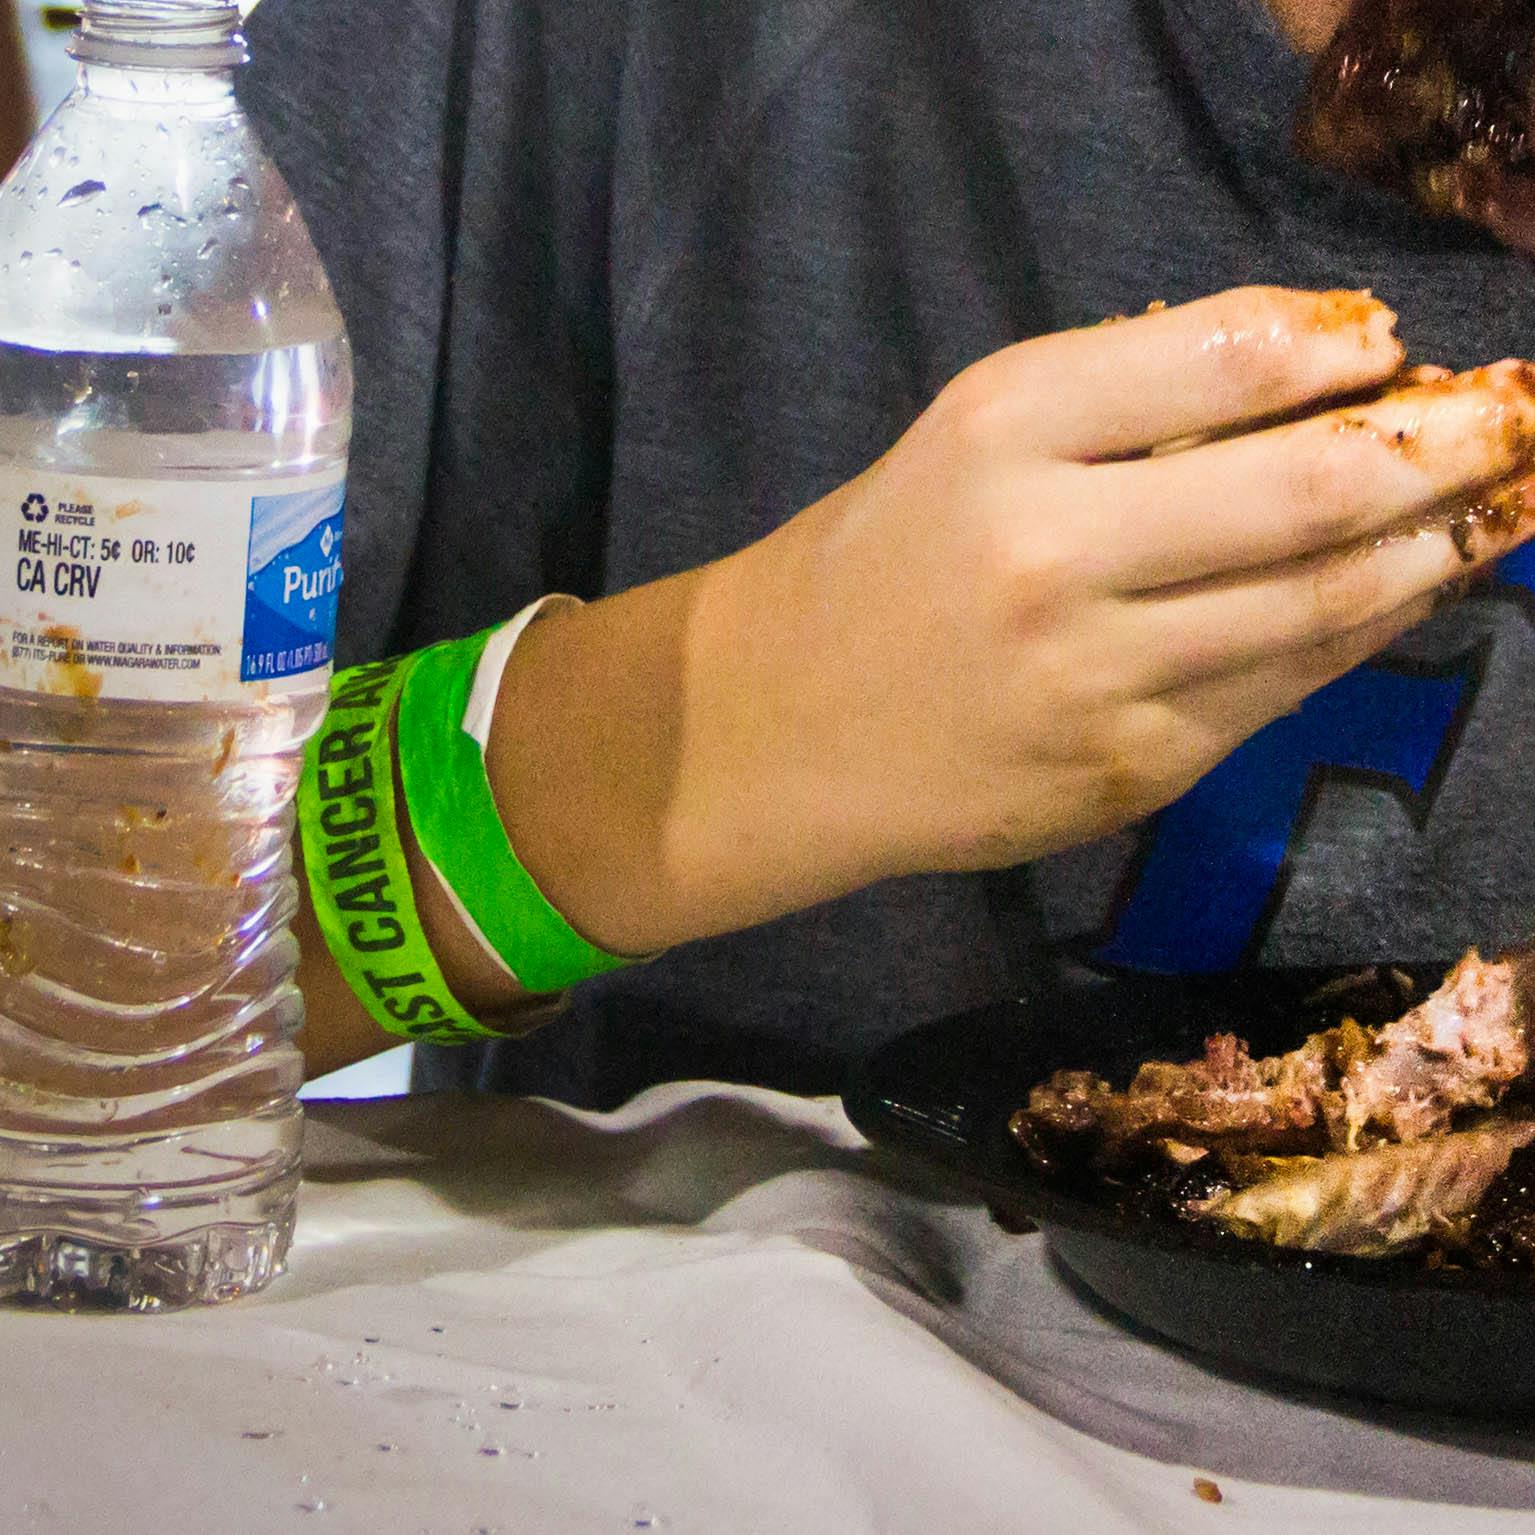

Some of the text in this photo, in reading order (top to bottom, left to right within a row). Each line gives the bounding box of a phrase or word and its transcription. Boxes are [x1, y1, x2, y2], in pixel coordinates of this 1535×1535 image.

[55, 514, 95, 526] RECYCLE
[58, 502, 94, 514] PLEASE
[18, 529, 196, 564] ME-HI-CT: 5¢ OR: 10¢
[17, 557, 102, 598] CA CRV
[12, 631, 28, 644] FOR
[87, 640, 116, 653] WATER
[118, 641, 153, 655] QUALITY
[317, 720, 406, 952] CANCER
